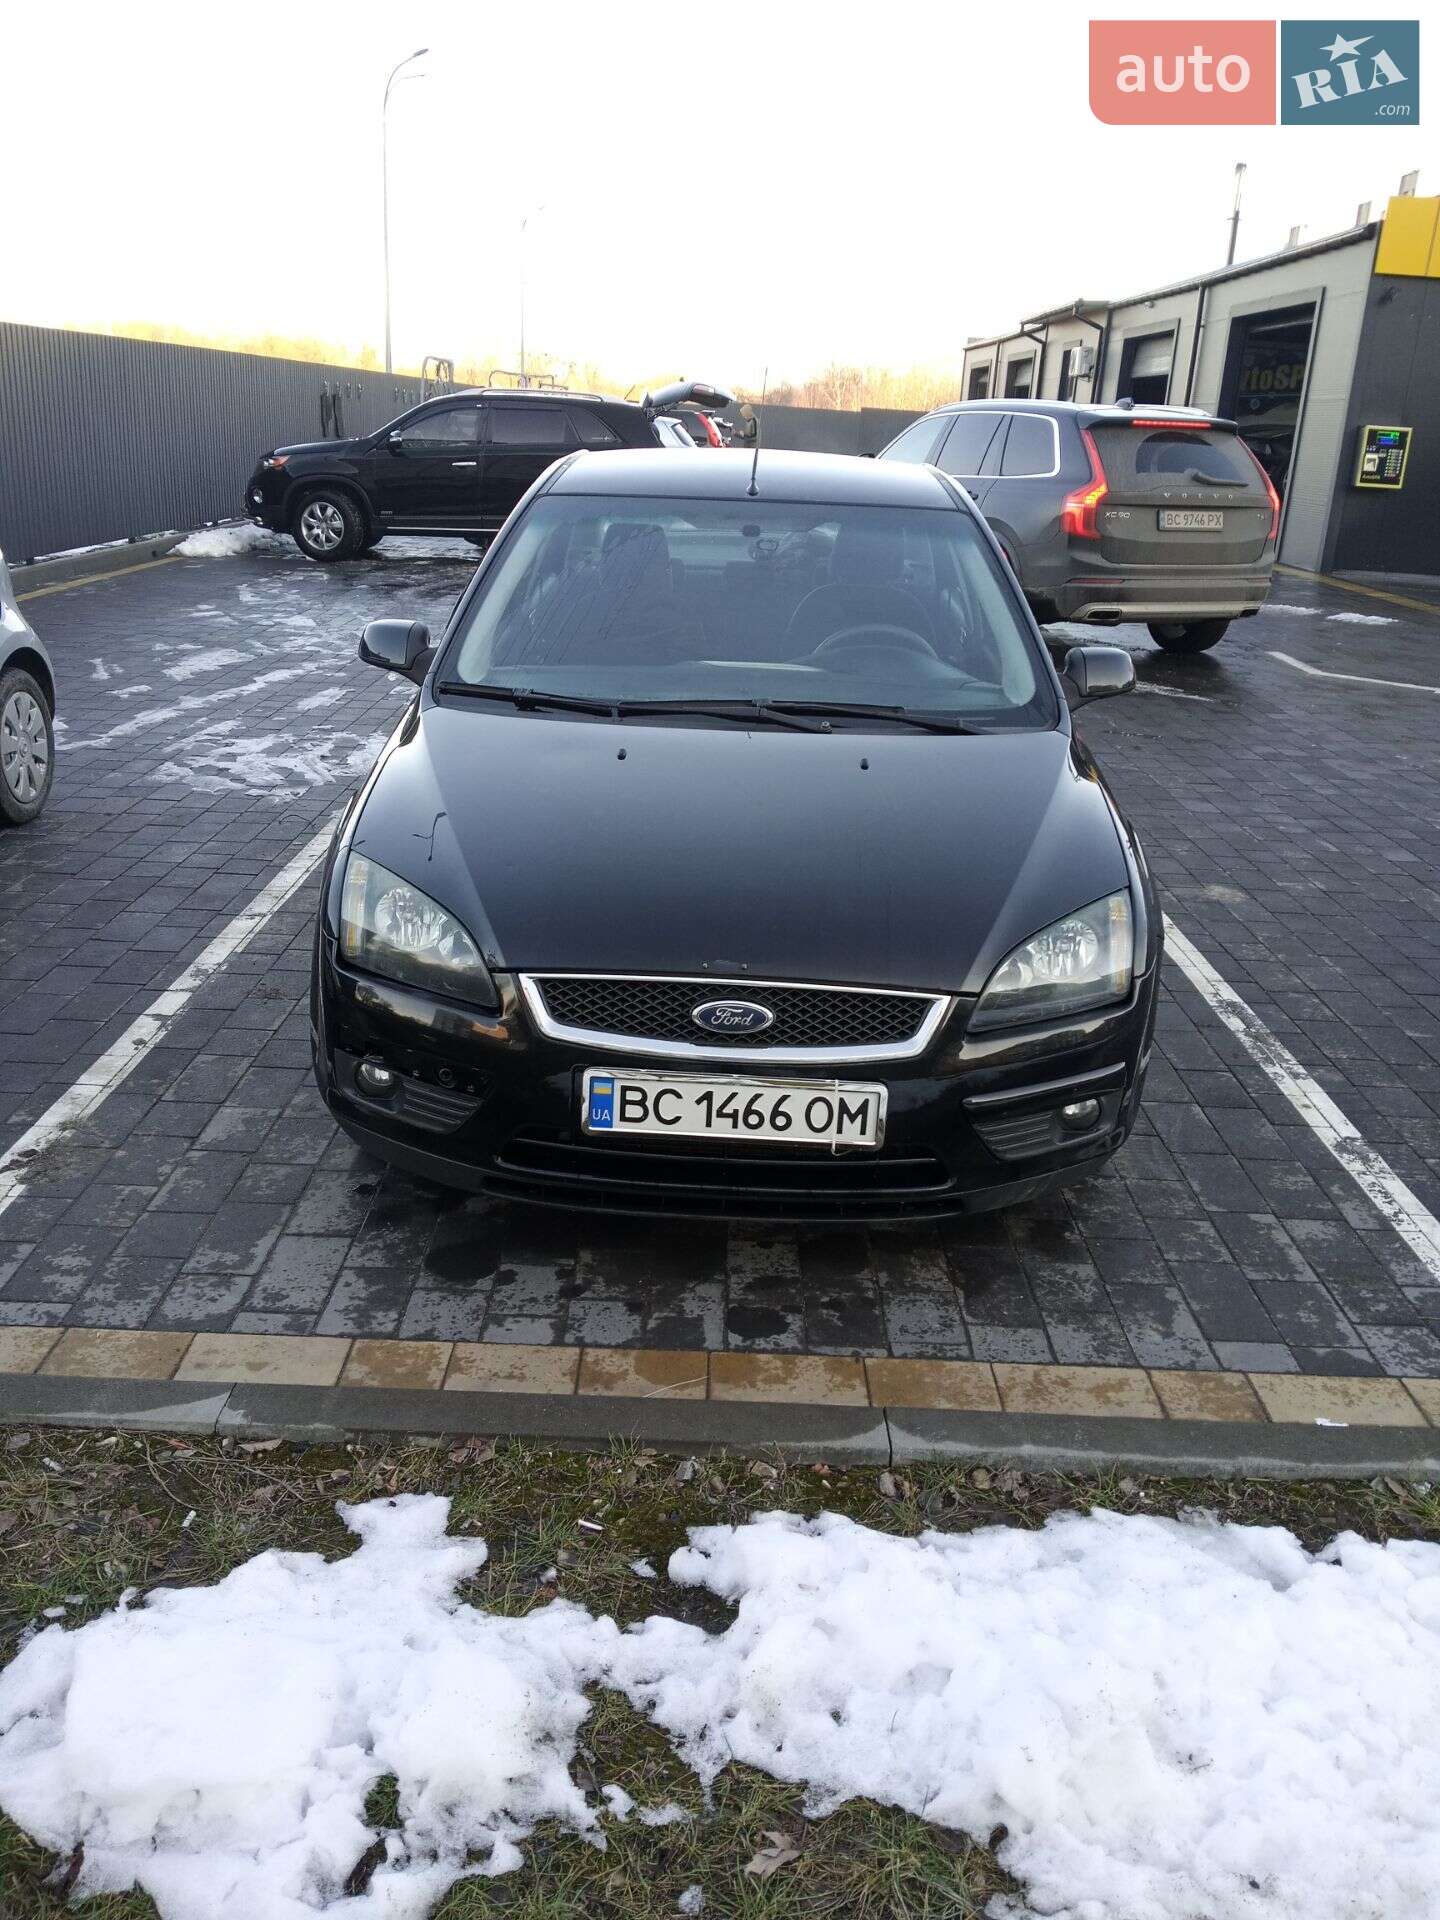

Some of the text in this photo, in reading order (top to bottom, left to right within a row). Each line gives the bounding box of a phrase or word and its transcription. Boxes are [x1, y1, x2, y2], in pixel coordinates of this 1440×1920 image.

[1166, 513, 1222, 527] BC 9746 PX
[711, 1007, 754, 1026] Ford
[592, 1109, 611, 1122] UA
[619, 1085, 871, 1136] BC 1466 OM
